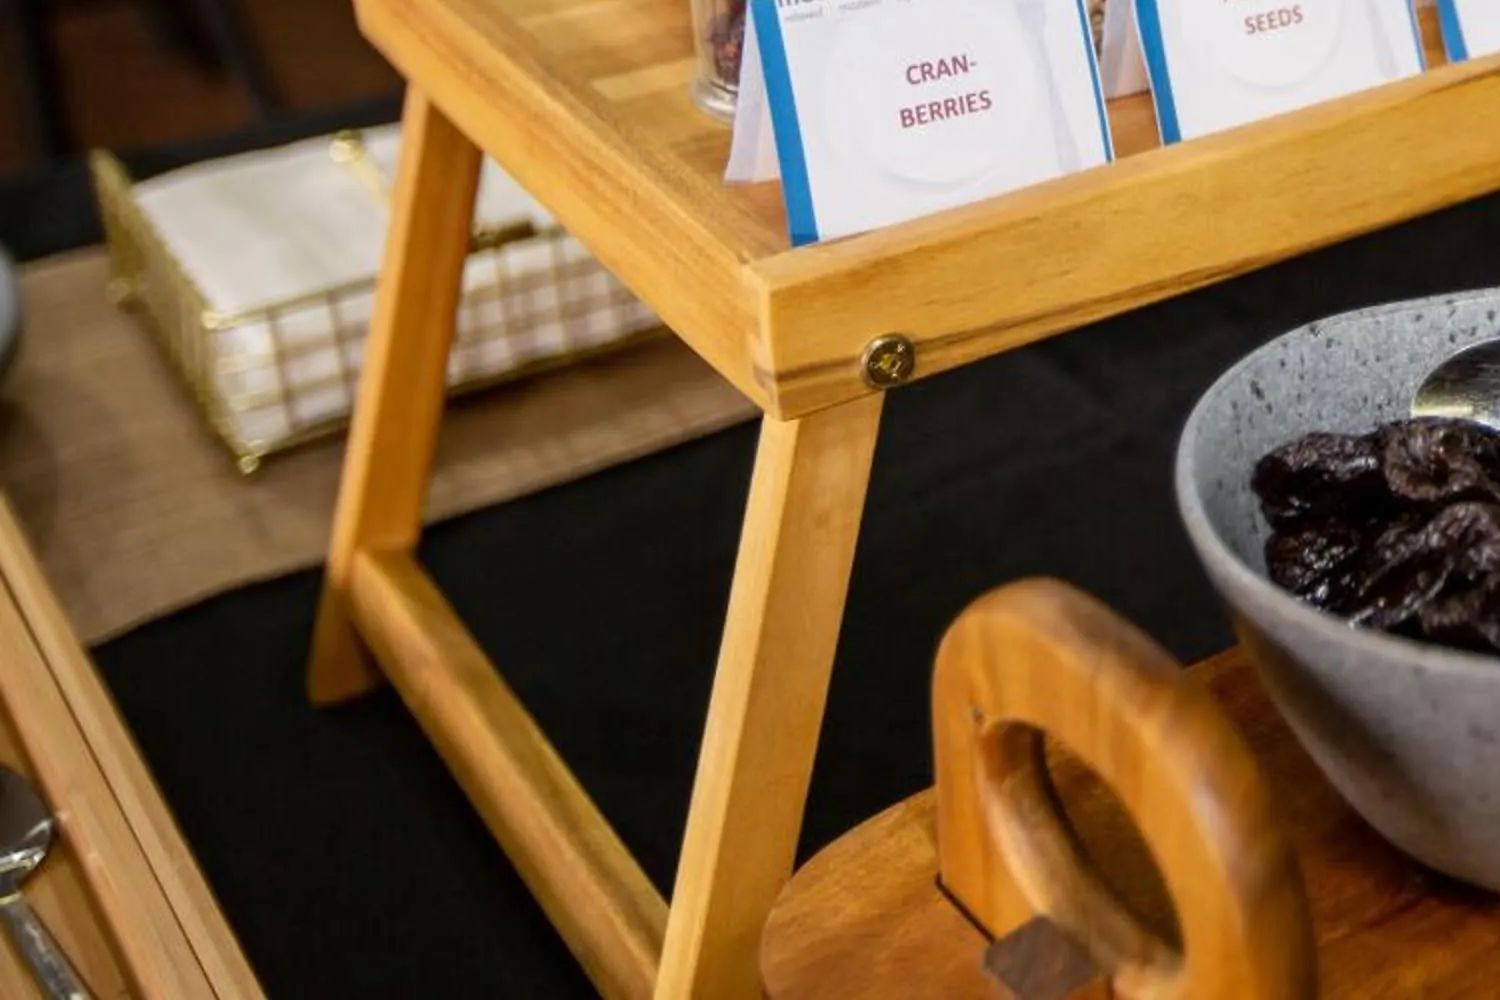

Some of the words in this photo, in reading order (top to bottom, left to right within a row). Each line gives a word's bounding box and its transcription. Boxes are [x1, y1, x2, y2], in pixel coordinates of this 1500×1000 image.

[1244, 4, 1304, 35] SEEDS
[905, 53, 977, 85] CRAN-
[900, 90, 993, 129] BERRIES
